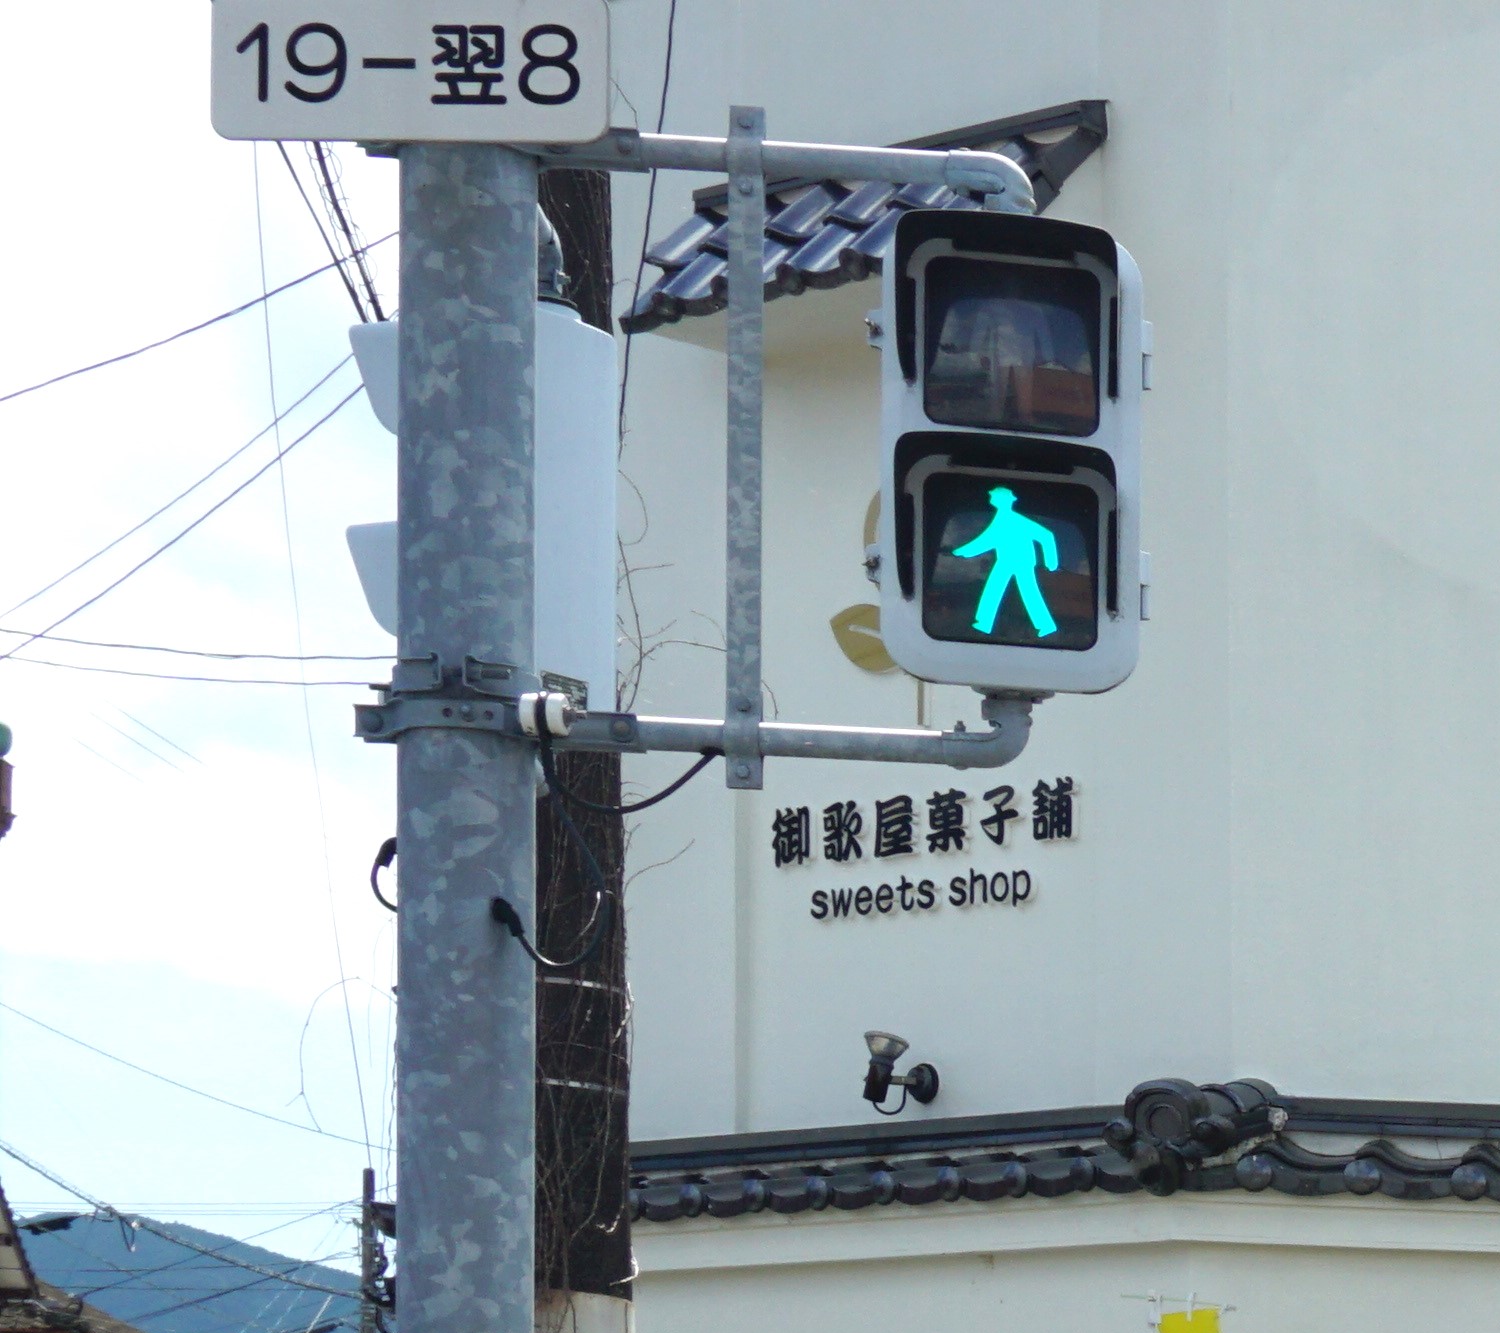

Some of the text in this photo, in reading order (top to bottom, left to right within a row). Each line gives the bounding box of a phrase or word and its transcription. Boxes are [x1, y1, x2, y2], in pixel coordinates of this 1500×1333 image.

[236, 23, 581, 105] 19-翌8
[810, 867, 1032, 920] sweets shop
